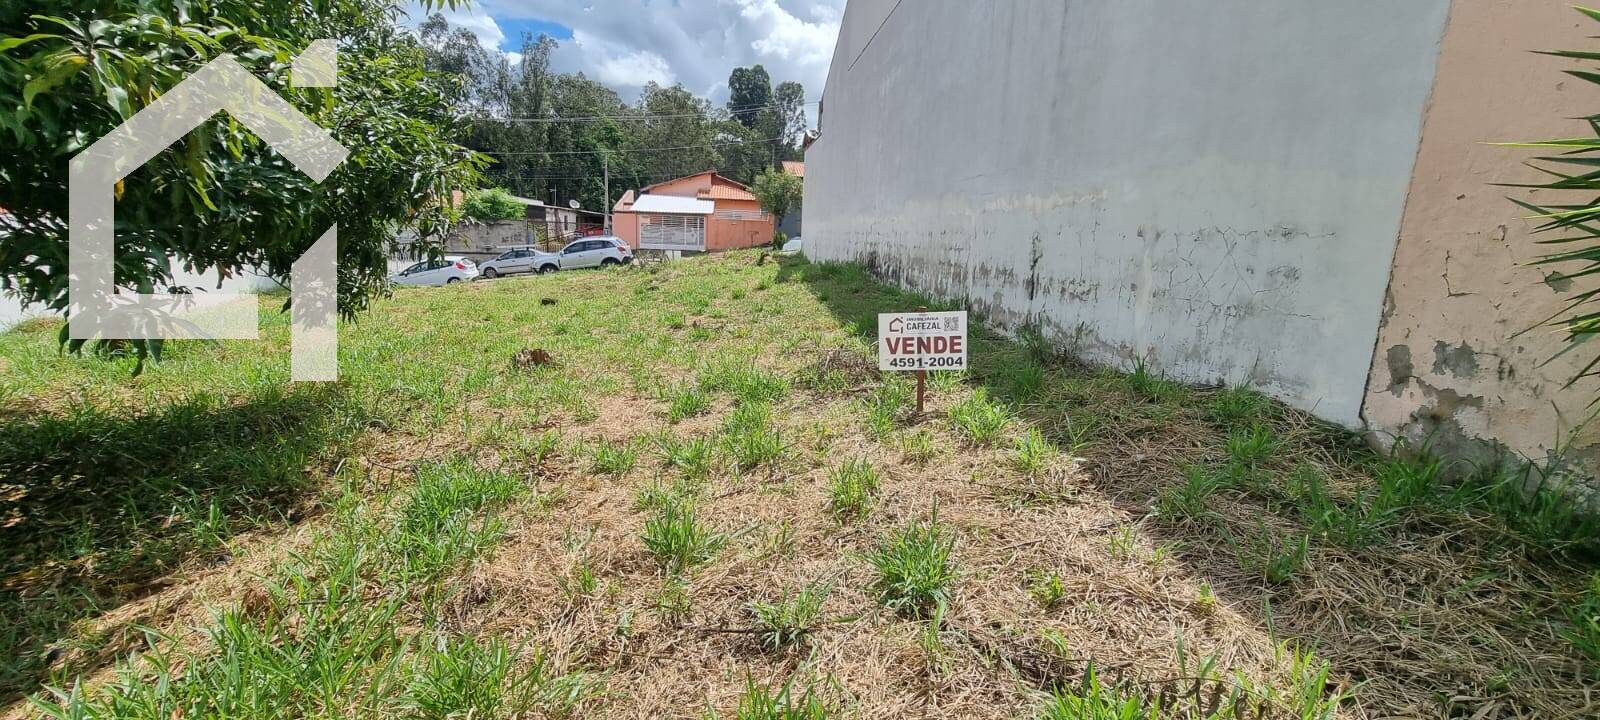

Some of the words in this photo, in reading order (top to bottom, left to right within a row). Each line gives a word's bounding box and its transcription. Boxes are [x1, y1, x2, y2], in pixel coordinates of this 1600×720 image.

[906, 322, 941, 330] CAFEZAL
[885, 336, 962, 355] VENDE
[889, 357, 963, 367] 4591-2004
